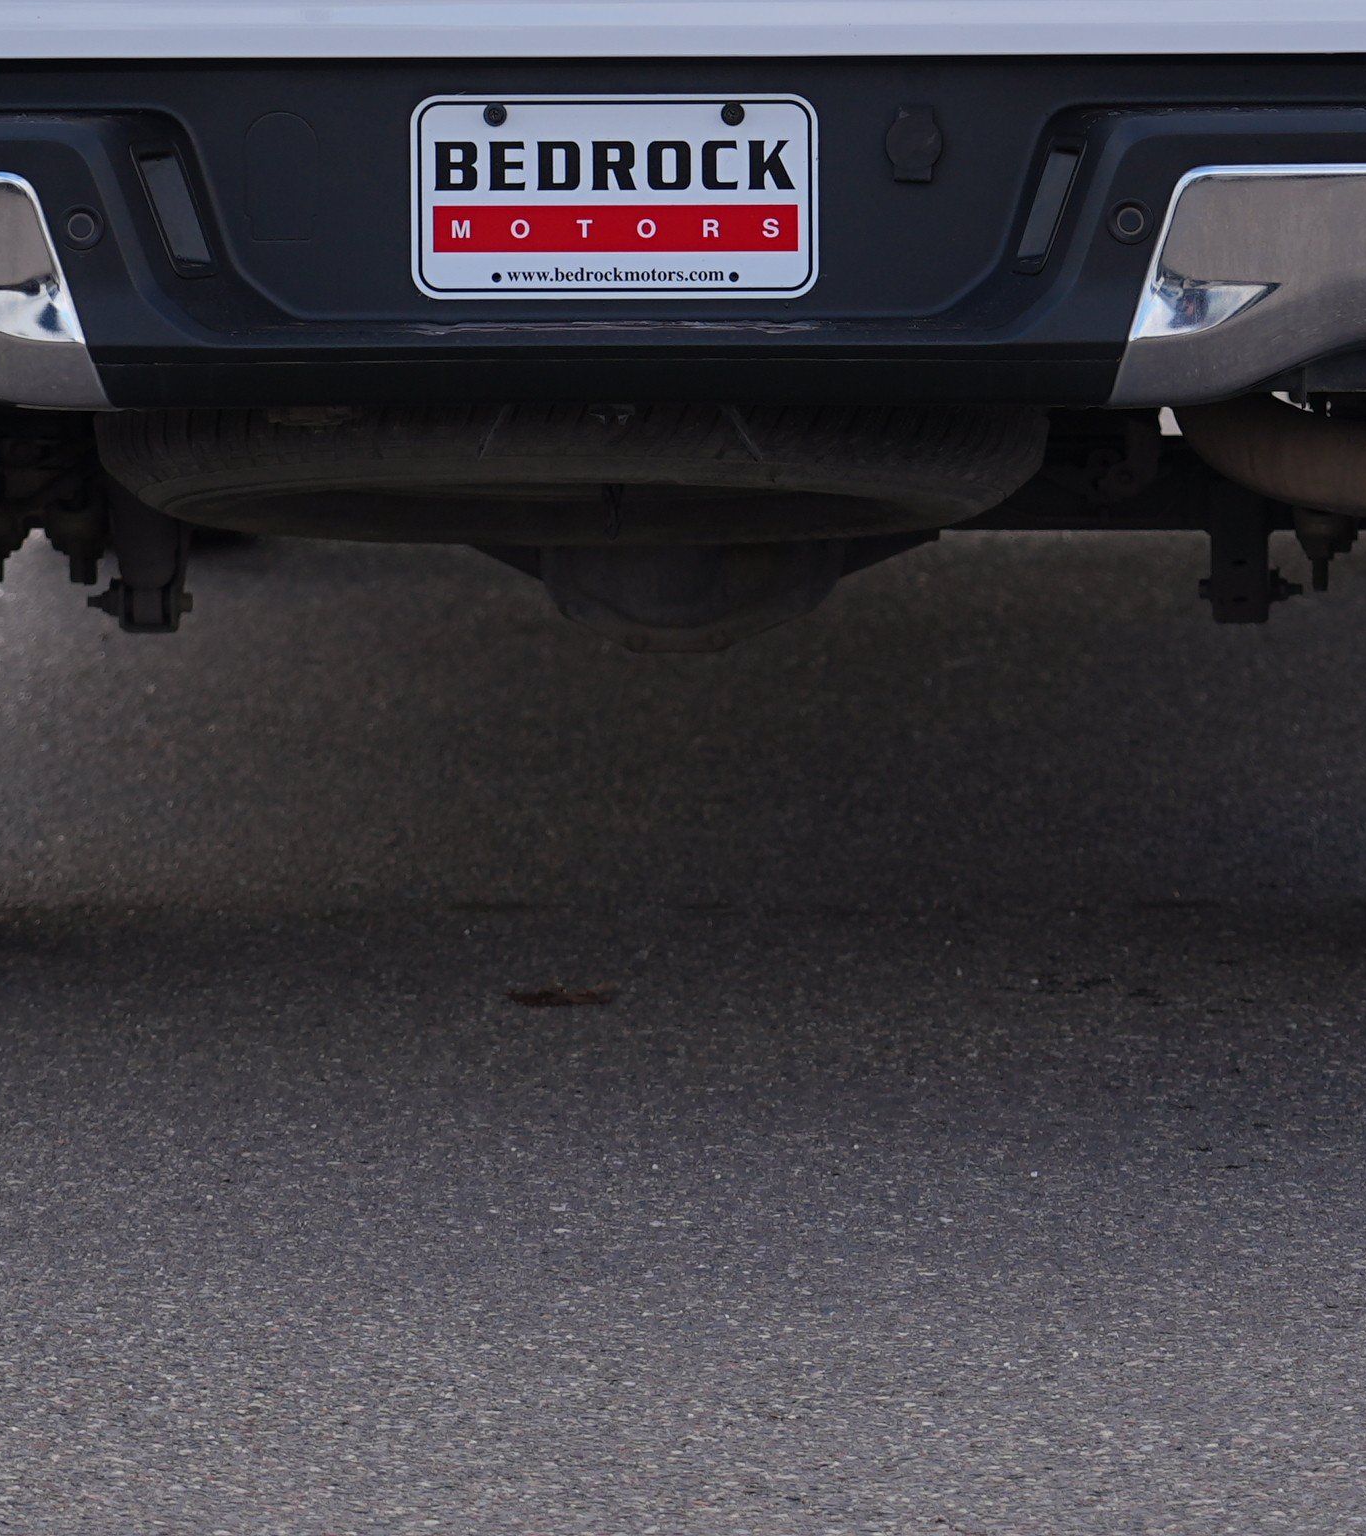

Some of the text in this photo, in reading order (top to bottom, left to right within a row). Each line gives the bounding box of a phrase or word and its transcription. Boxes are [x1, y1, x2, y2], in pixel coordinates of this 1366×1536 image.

[433, 140, 796, 192] BEDROCK
[450, 217, 780, 239] MOTORS
[506, 266, 725, 283] www.bedrockmotors.com
